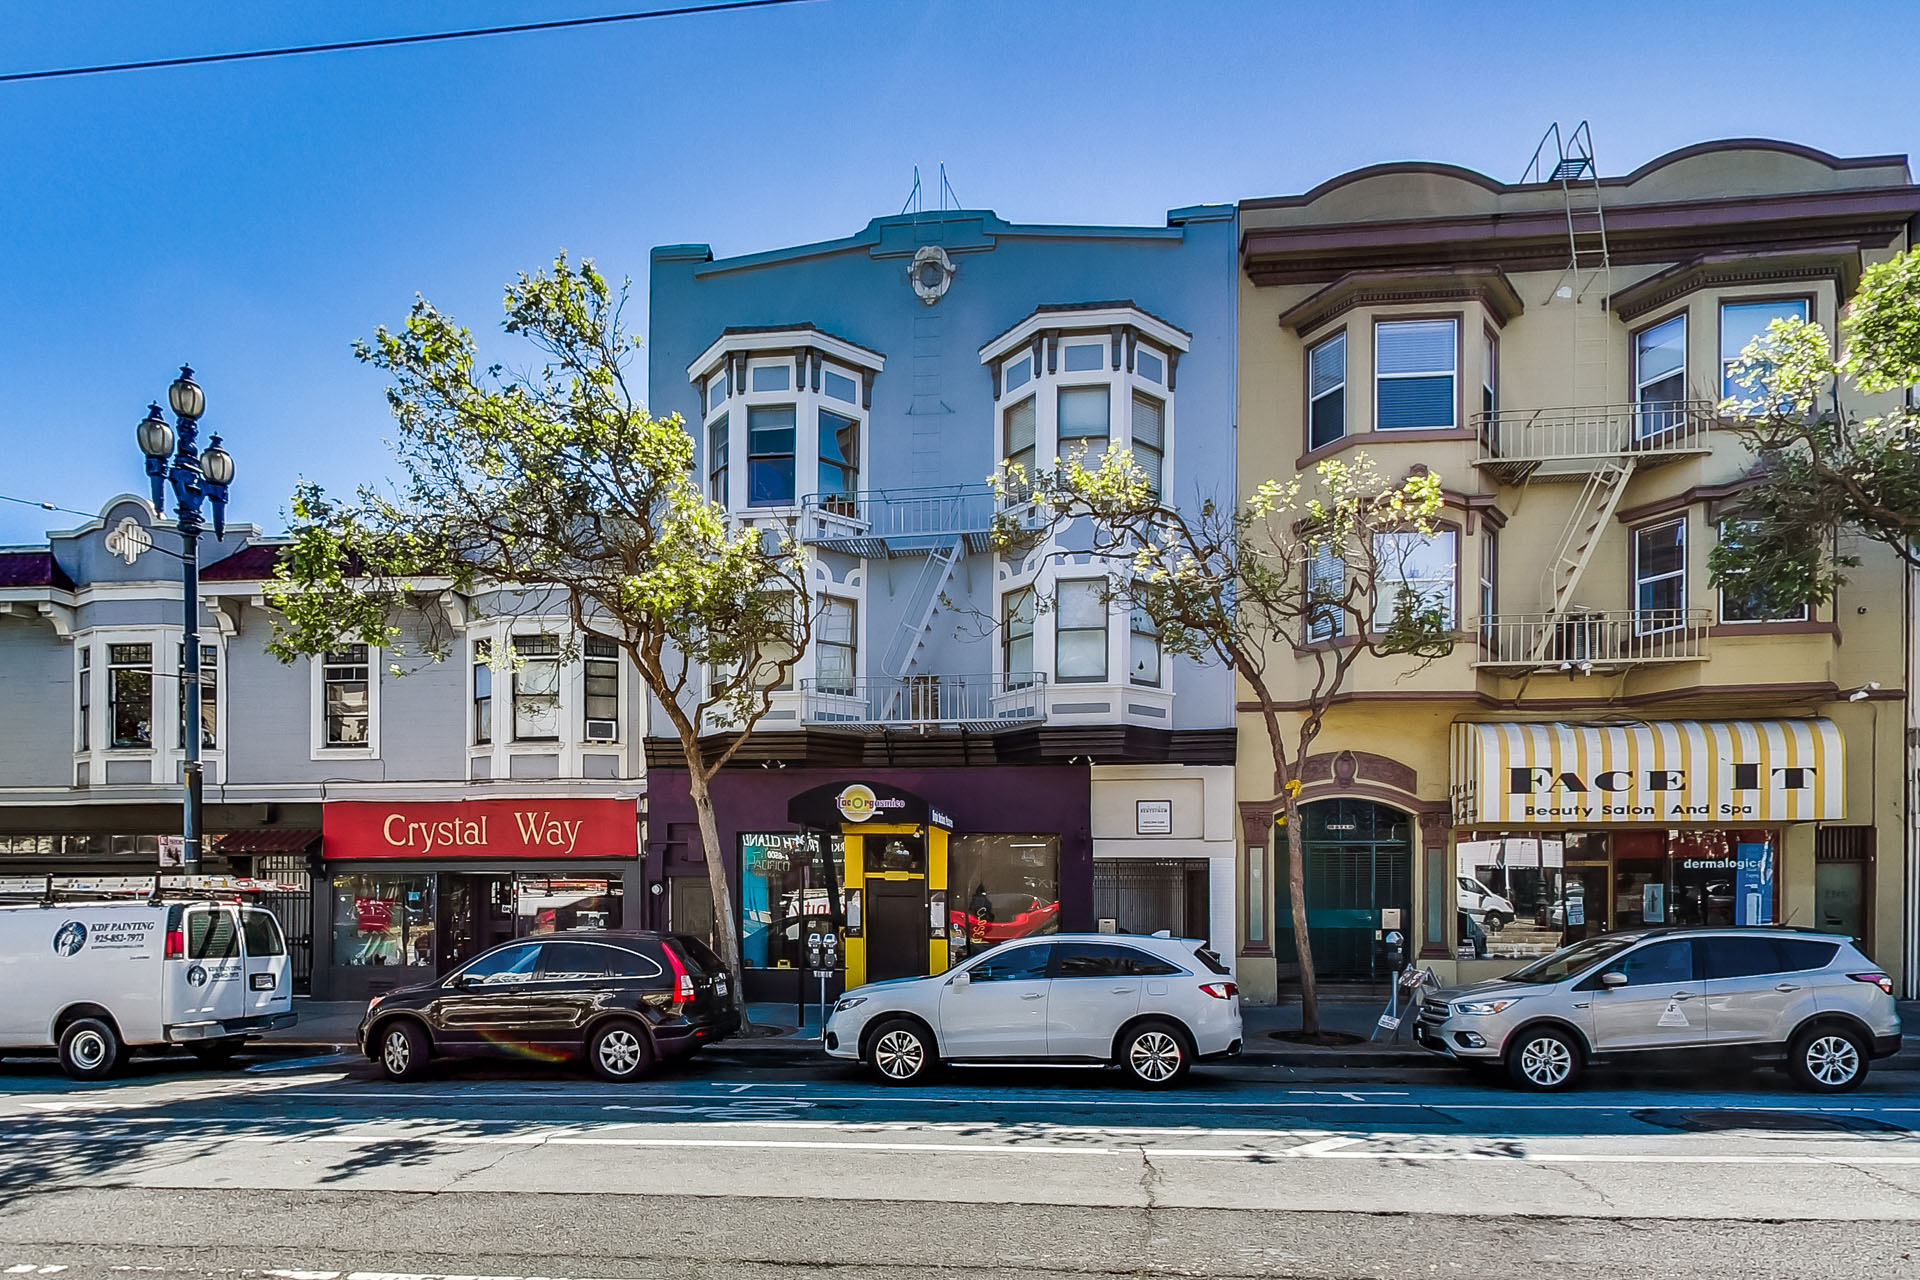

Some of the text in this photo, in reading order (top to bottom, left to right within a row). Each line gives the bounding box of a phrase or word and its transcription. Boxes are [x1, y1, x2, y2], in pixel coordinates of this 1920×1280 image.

[1506, 766, 1686, 794] FACE
[1730, 762, 1817, 790] IT
[1525, 803, 1752, 818] Beauty Salon And Spa
[383, 812, 584, 854] Crystal Way
[110, 922, 155, 931] PAINTING
